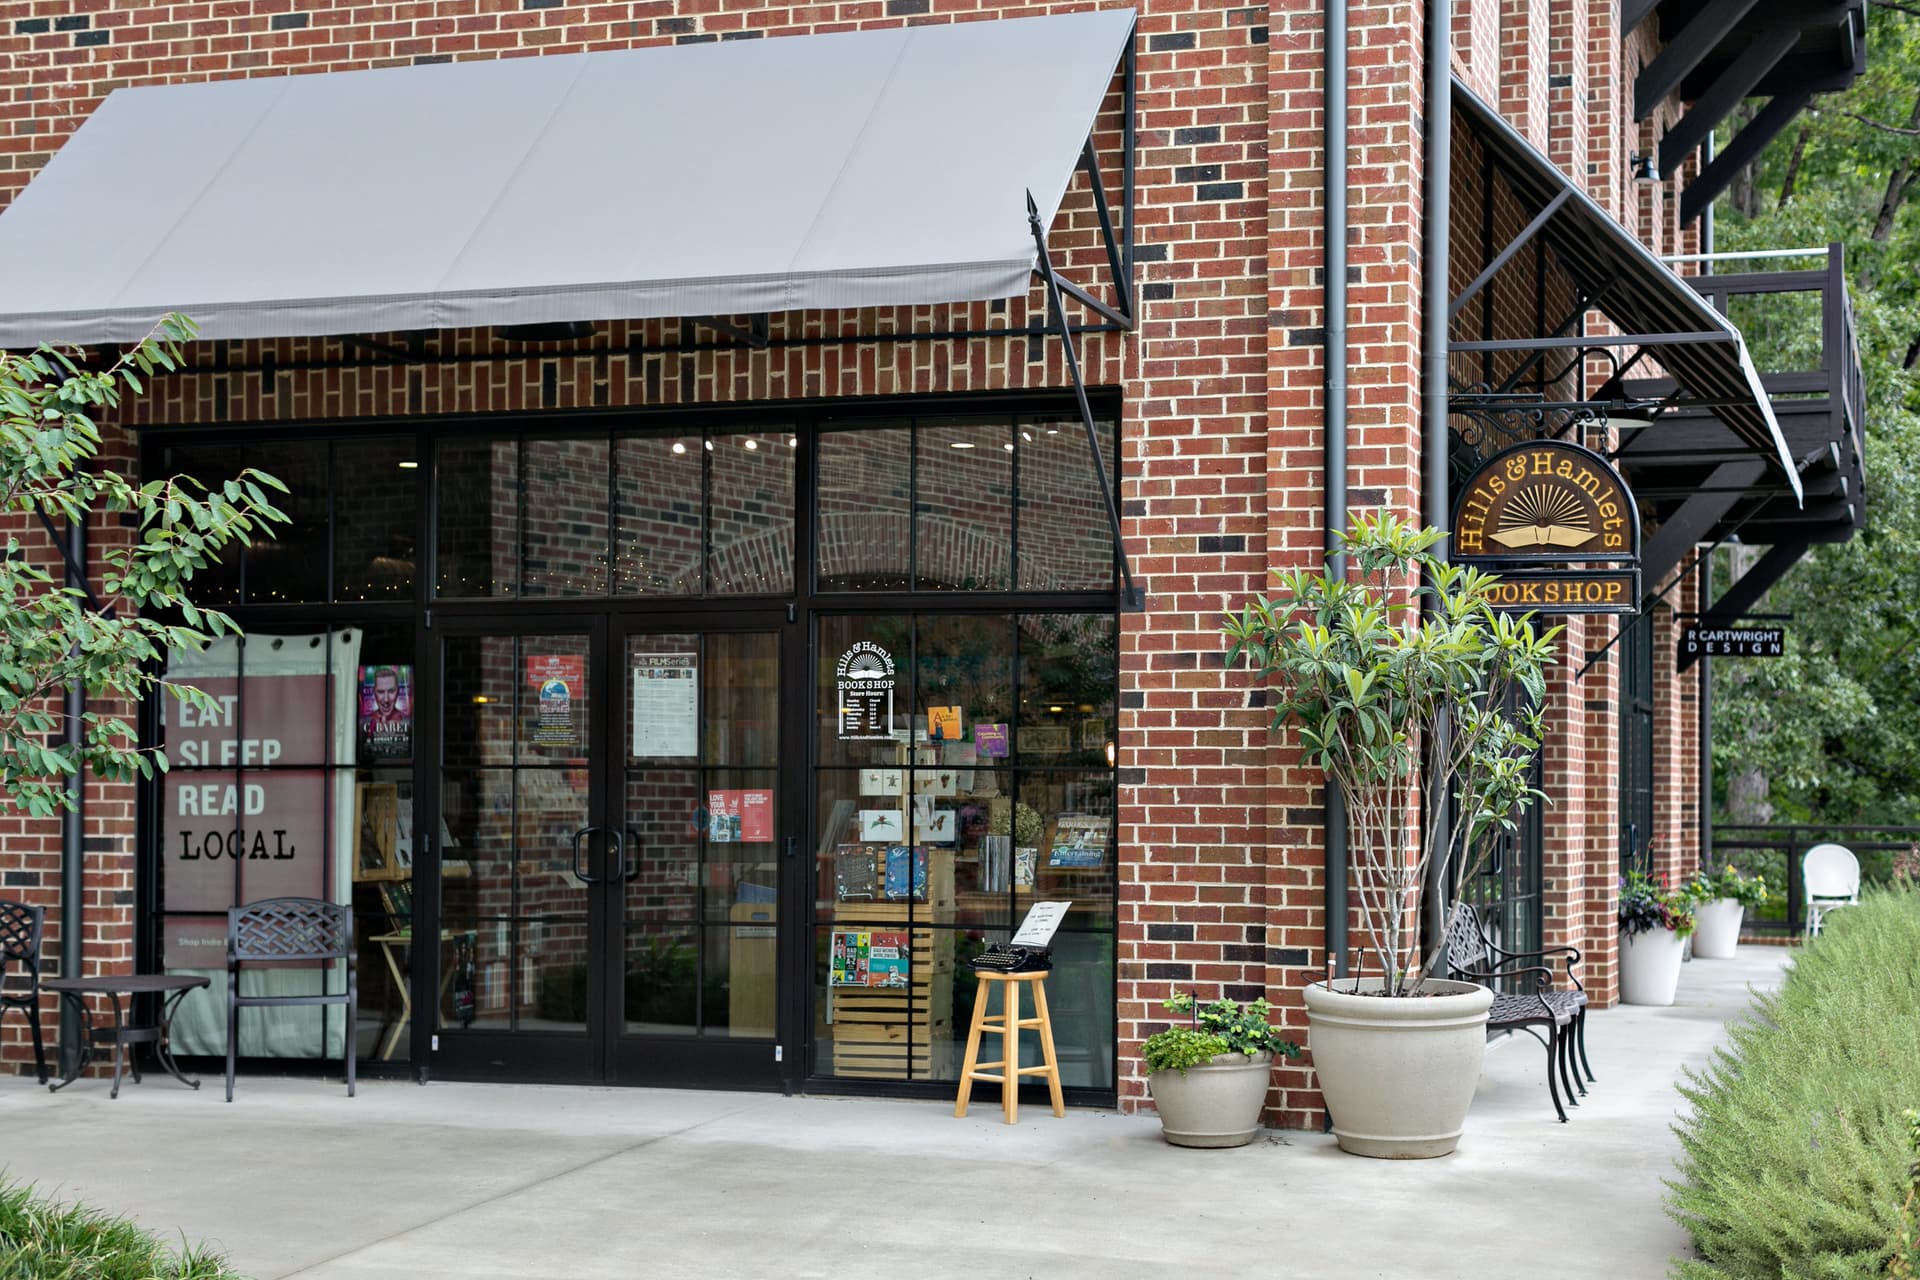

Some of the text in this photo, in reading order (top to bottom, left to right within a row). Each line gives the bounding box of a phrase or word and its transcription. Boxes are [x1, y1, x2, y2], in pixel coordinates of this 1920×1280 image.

[1460, 452, 1624, 550] Hills & Hamlets
[1688, 630, 1780, 642] R CARTWRIGHT
[1688, 642, 1780, 653] DESIGN
[837, 650, 854, 677] Hills
[861, 641, 896, 676] Hamlets
[837, 680, 895, 690] BOOKSHOP
[179, 695, 238, 727] EAT
[363, 720, 410, 733] CBARET
[178, 784, 265, 816] READ
[179, 829, 295, 860] LOCAL
